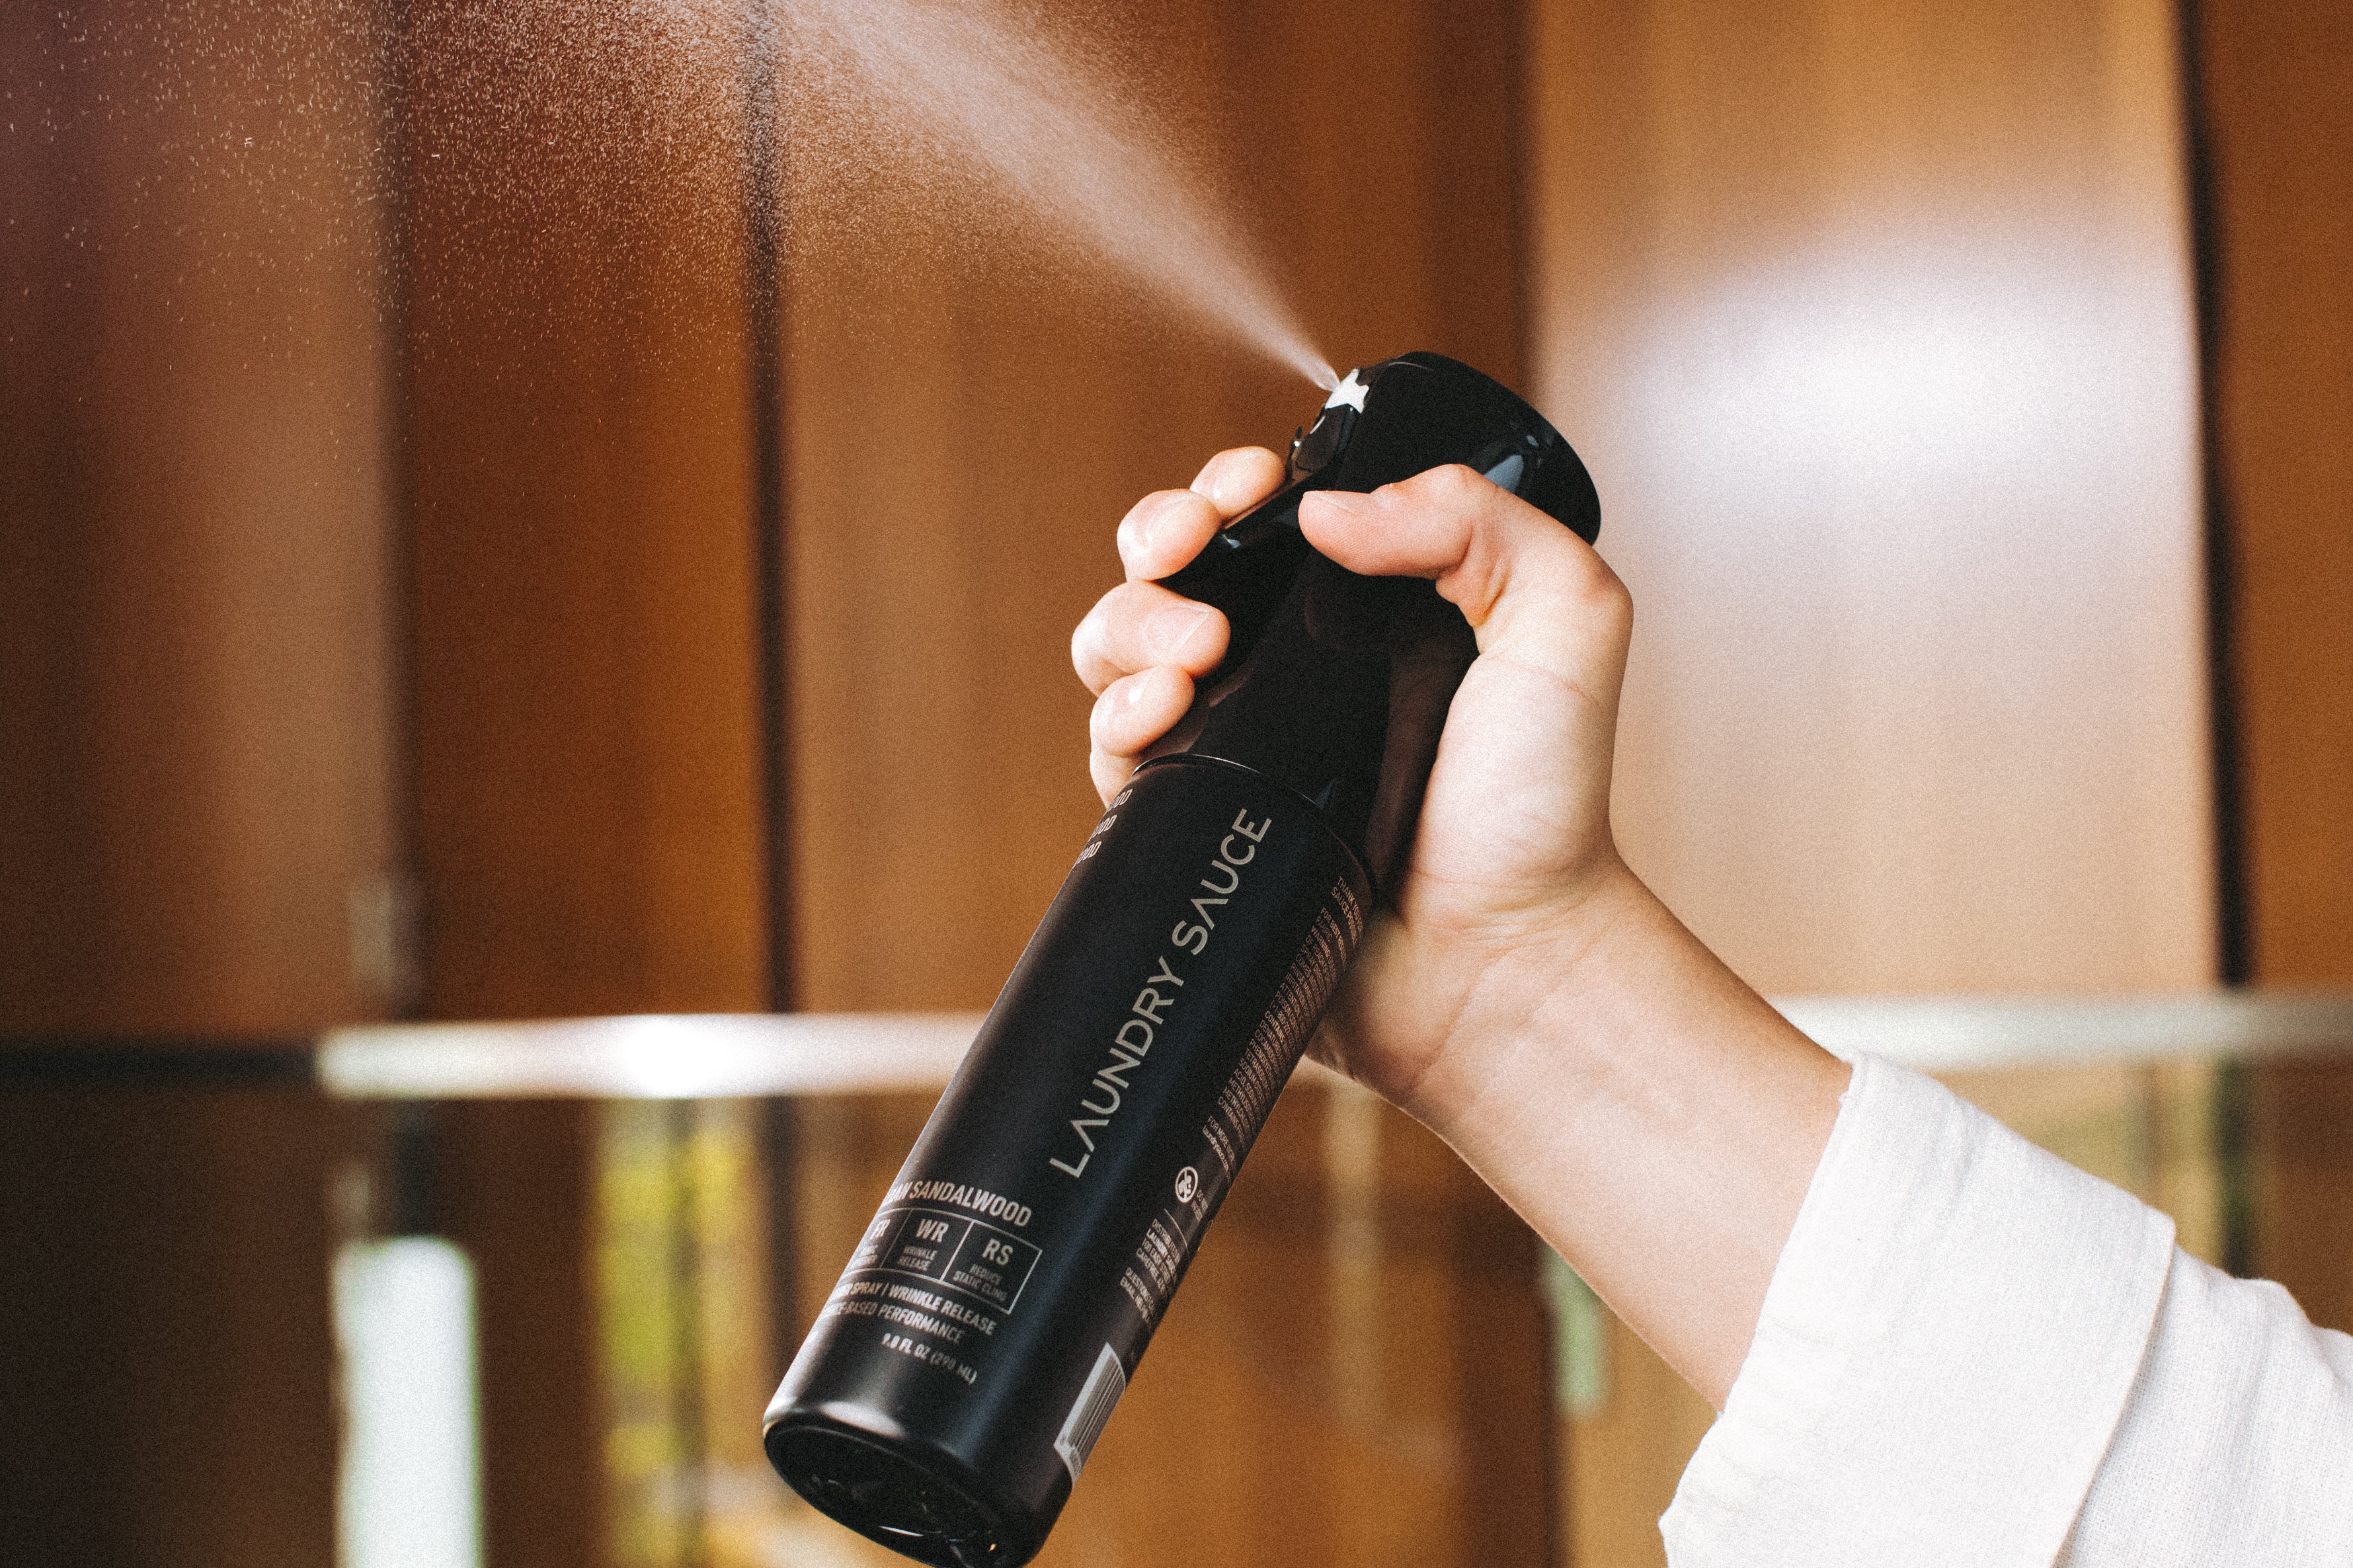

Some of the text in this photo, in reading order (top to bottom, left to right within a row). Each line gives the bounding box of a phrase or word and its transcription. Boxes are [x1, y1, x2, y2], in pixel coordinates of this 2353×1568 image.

[1331, 886, 1349, 915] SAUCE
[1337, 876, 1355, 902] THANK
[1320, 907, 1332, 921] FOR
[1049, 808, 1273, 1179] LAUNDRY SAUCE
[908, 1181, 1032, 1229] SANDALWOOD
[915, 1218, 949, 1243] WR
[982, 1238, 1014, 1265] RS
[850, 1282, 883, 1295] SPRAY
[889, 1285, 943, 1311] WRINKLE
[941, 1300, 996, 1335] RELEASE
[878, 1304, 963, 1343] PERFORMANCE
[898, 1338, 913, 1354] FL
[914, 1343, 931, 1359] OZ
